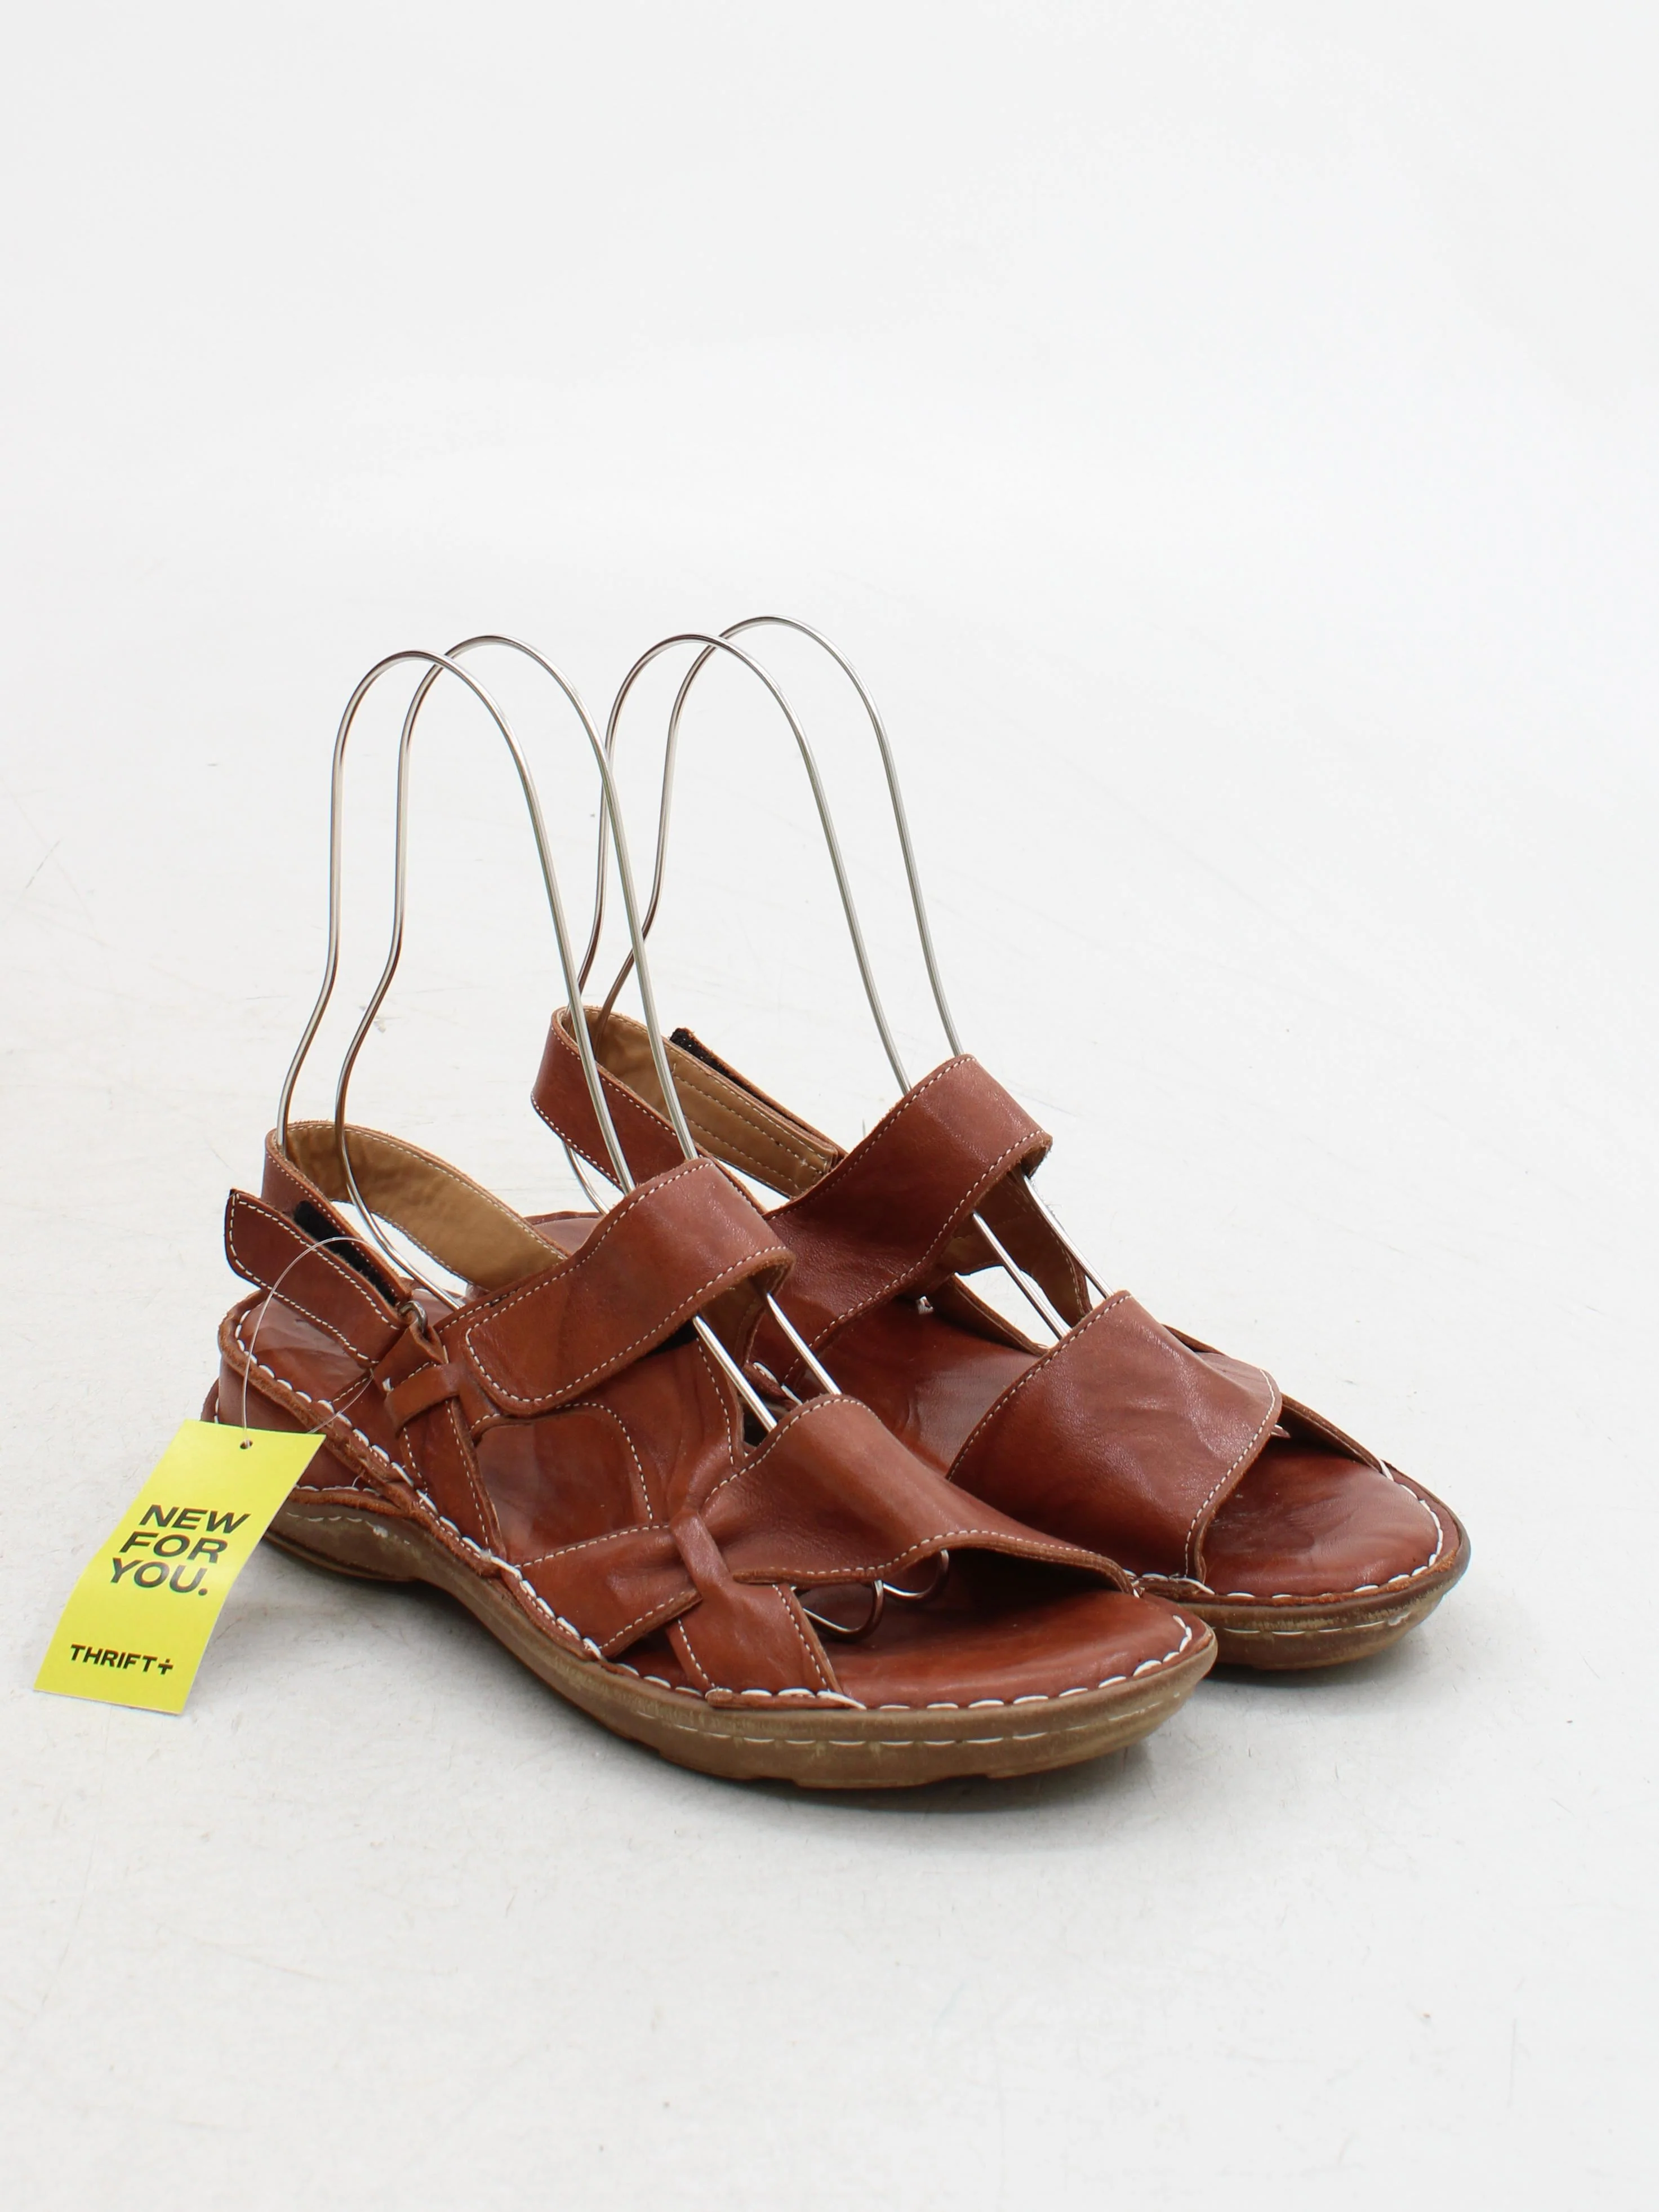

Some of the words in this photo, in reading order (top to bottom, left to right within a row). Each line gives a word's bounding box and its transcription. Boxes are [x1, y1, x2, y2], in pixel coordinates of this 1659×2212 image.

[139, 1504, 251, 1534] NEW
[119, 1531, 228, 1563] FOR
[111, 1558, 208, 1596] YOU.
